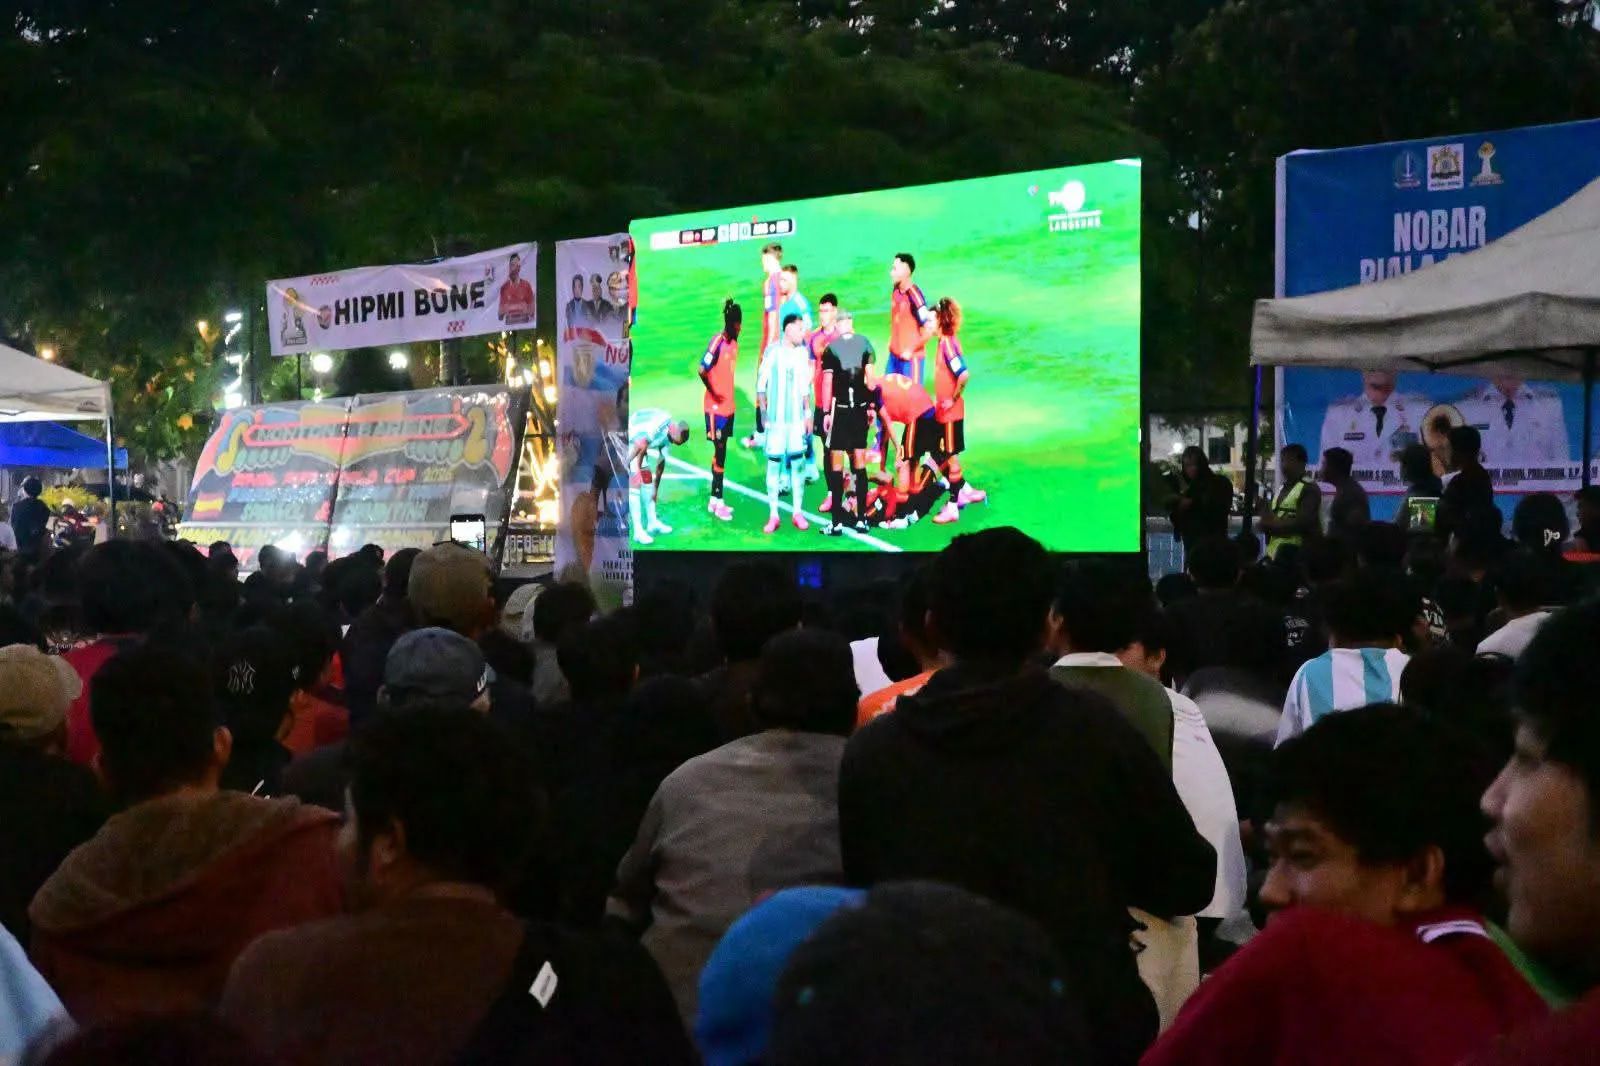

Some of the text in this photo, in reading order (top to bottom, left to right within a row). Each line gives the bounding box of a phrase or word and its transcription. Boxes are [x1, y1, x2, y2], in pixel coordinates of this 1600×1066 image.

[1393, 205, 1487, 253] NOBAR
[334, 280, 486, 325] HIPMI BONE
